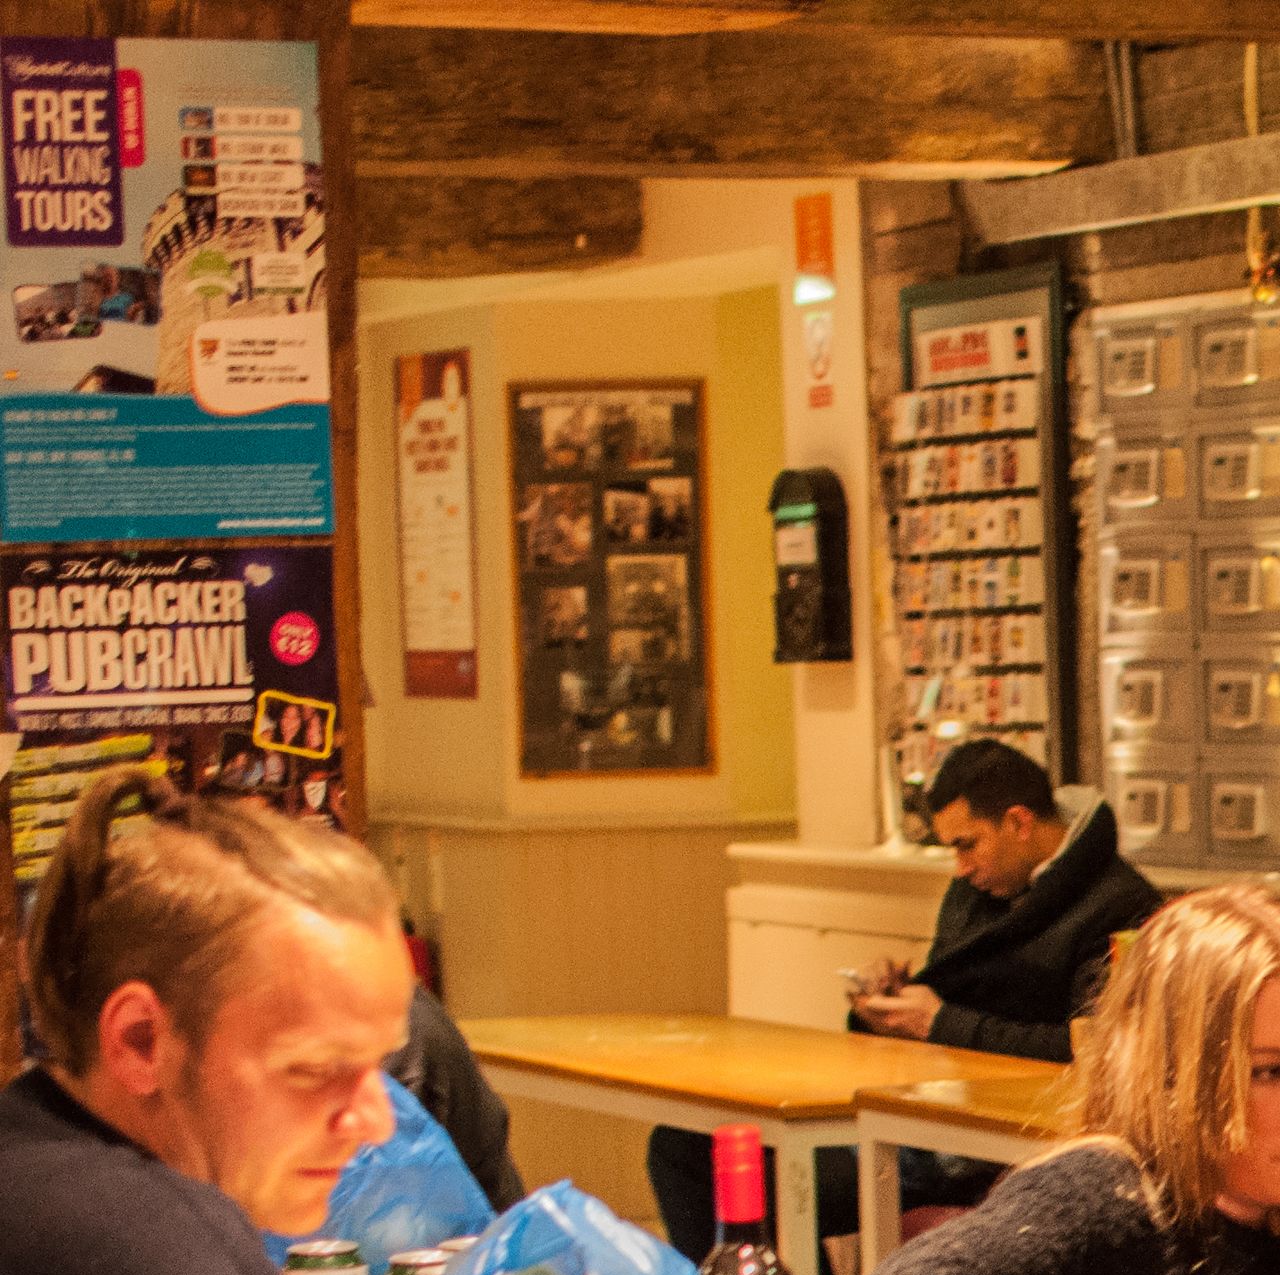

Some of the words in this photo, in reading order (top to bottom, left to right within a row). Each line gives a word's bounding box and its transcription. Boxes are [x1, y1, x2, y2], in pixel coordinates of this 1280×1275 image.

[12, 89, 109, 142] FREE
[13, 145, 112, 185] WALKING
[14, 190, 113, 232] TOURS
[57, 558, 99, 580] The
[99, 555, 188, 588] Original
[12, 625, 255, 694] PUBCRAWL
